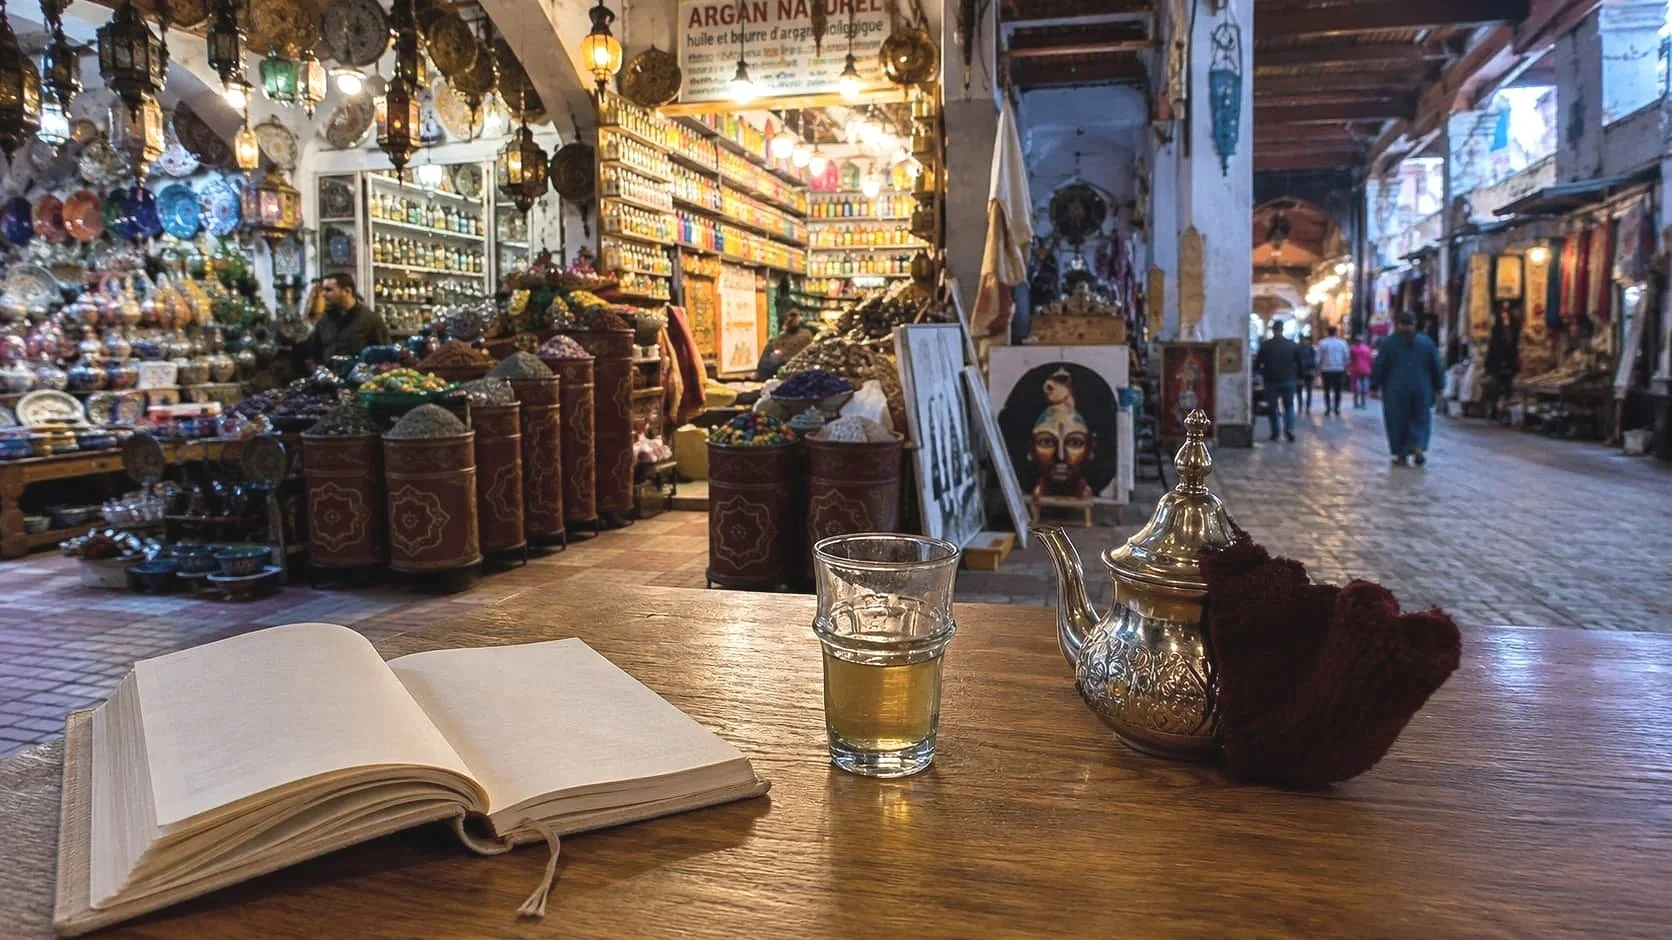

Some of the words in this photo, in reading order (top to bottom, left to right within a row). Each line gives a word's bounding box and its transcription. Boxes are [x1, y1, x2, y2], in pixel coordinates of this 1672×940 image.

[688, 0, 768, 28] ARGAN
[777, 0, 882, 20] NAUREL
[687, 32, 714, 47] huile
[717, 32, 728, 45] et
